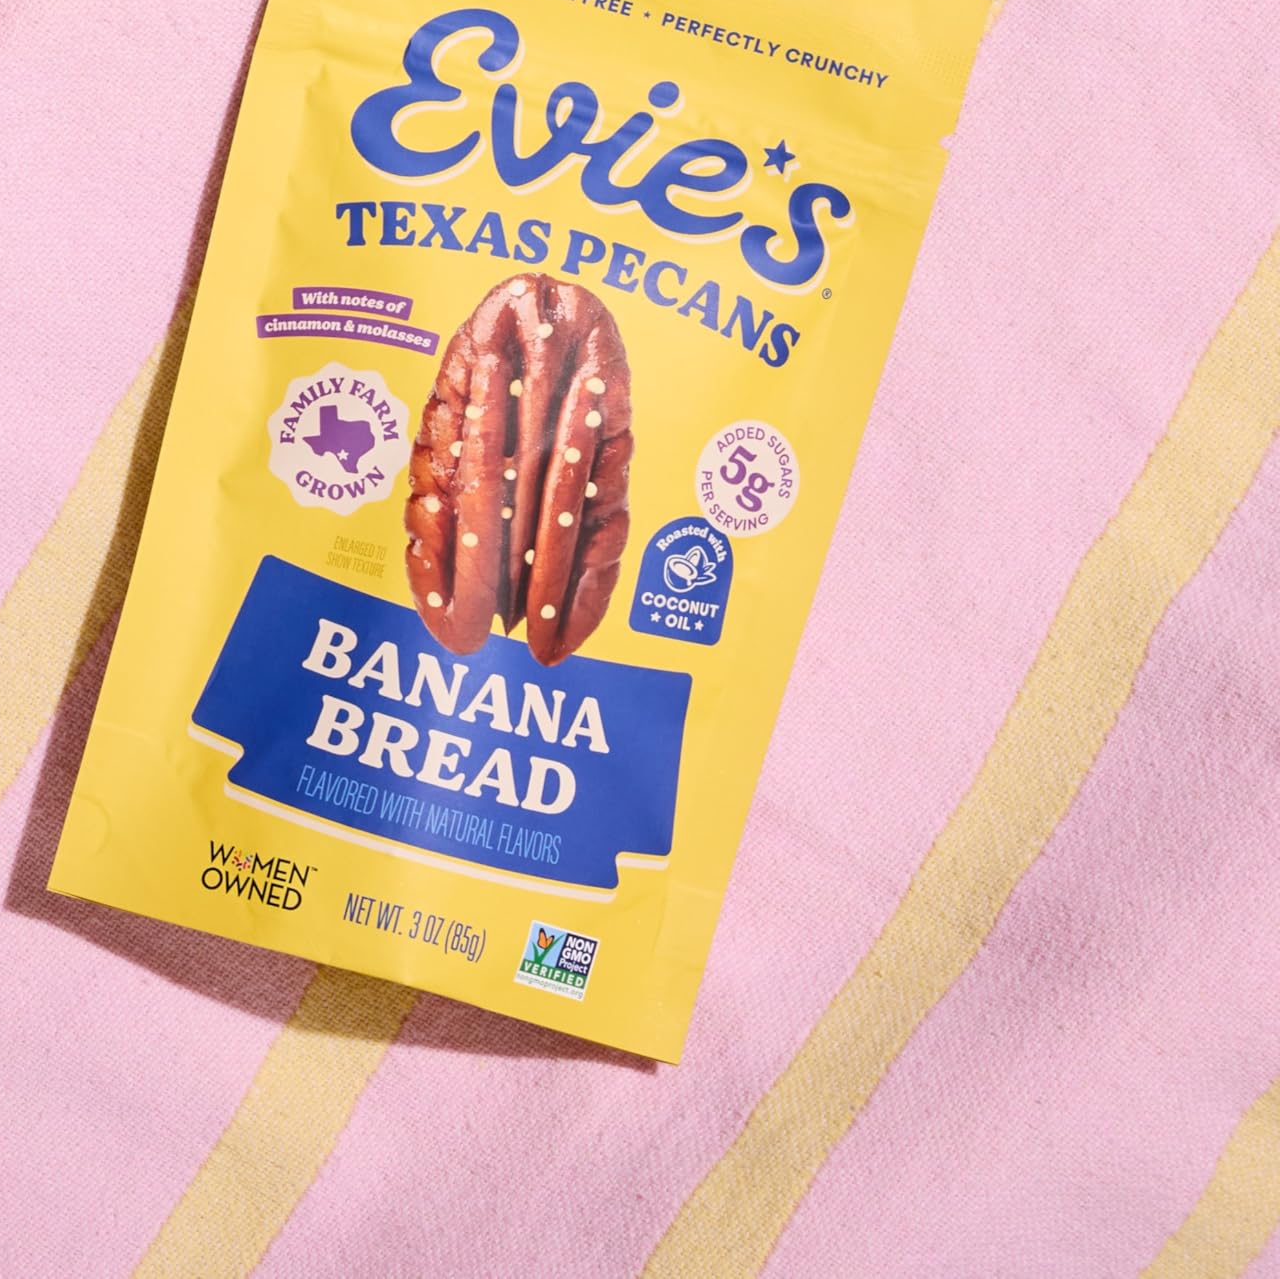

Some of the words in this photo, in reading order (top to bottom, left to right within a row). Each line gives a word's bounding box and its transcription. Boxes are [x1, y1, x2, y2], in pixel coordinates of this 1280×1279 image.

[661, 12, 781, 57] PERFECTLY
[785, 48, 888, 88] CRUNCHY
[350, 7, 854, 290] Evie's
[301, 291, 339, 306] With
[340, 294, 384, 310] notes
[385, 301, 407, 315] of
[336, 201, 551, 264] TEXAS
[565, 230, 801, 369] PECANS
[264, 318, 341, 332] cinnamon
[343, 320, 355, 332] &
[357, 322, 432, 348] molasses
[279, 377, 345, 444] FAMILY
[349, 379, 399, 442] FARM
[295, 466, 385, 500] GROWN
[716, 426, 766, 454] ADDED
[767, 435, 793, 500] SUGARS
[719, 445, 775, 512] 5g
[701, 470, 715, 503] PER
[709, 504, 769, 531] SERVING
[333, 535, 375, 559] ENLARGED
[375, 546, 387, 561] TO
[656, 524, 709, 552] Roasted
[707, 529, 728, 563] with
[325, 551, 352, 570] SHOW
[352, 558, 387, 578] TEXTURE
[641, 591, 720, 618] COCONUT
[665, 614, 691, 631] OIL
[302, 618, 610, 754] BANANA
[306, 694, 577, 815] BREAD
[296, 764, 379, 815] FLAVORED
[379, 790, 424, 829] WITH
[425, 804, 494, 850] NATURAL
[497, 823, 562, 865] FLAVORS
[201, 867, 303, 911] OWNED
[343, 892, 376, 927] NET
[376, 900, 405, 936] WT.
[409, 910, 423, 939] 3
[423, 914, 446, 946] OZ
[444, 920, 487, 963] (85g)
[565, 936, 595, 953] NON
[524, 961, 584, 987] VERIFIED
[558, 958, 588, 974] Project
[561, 947, 591, 965] GMO
